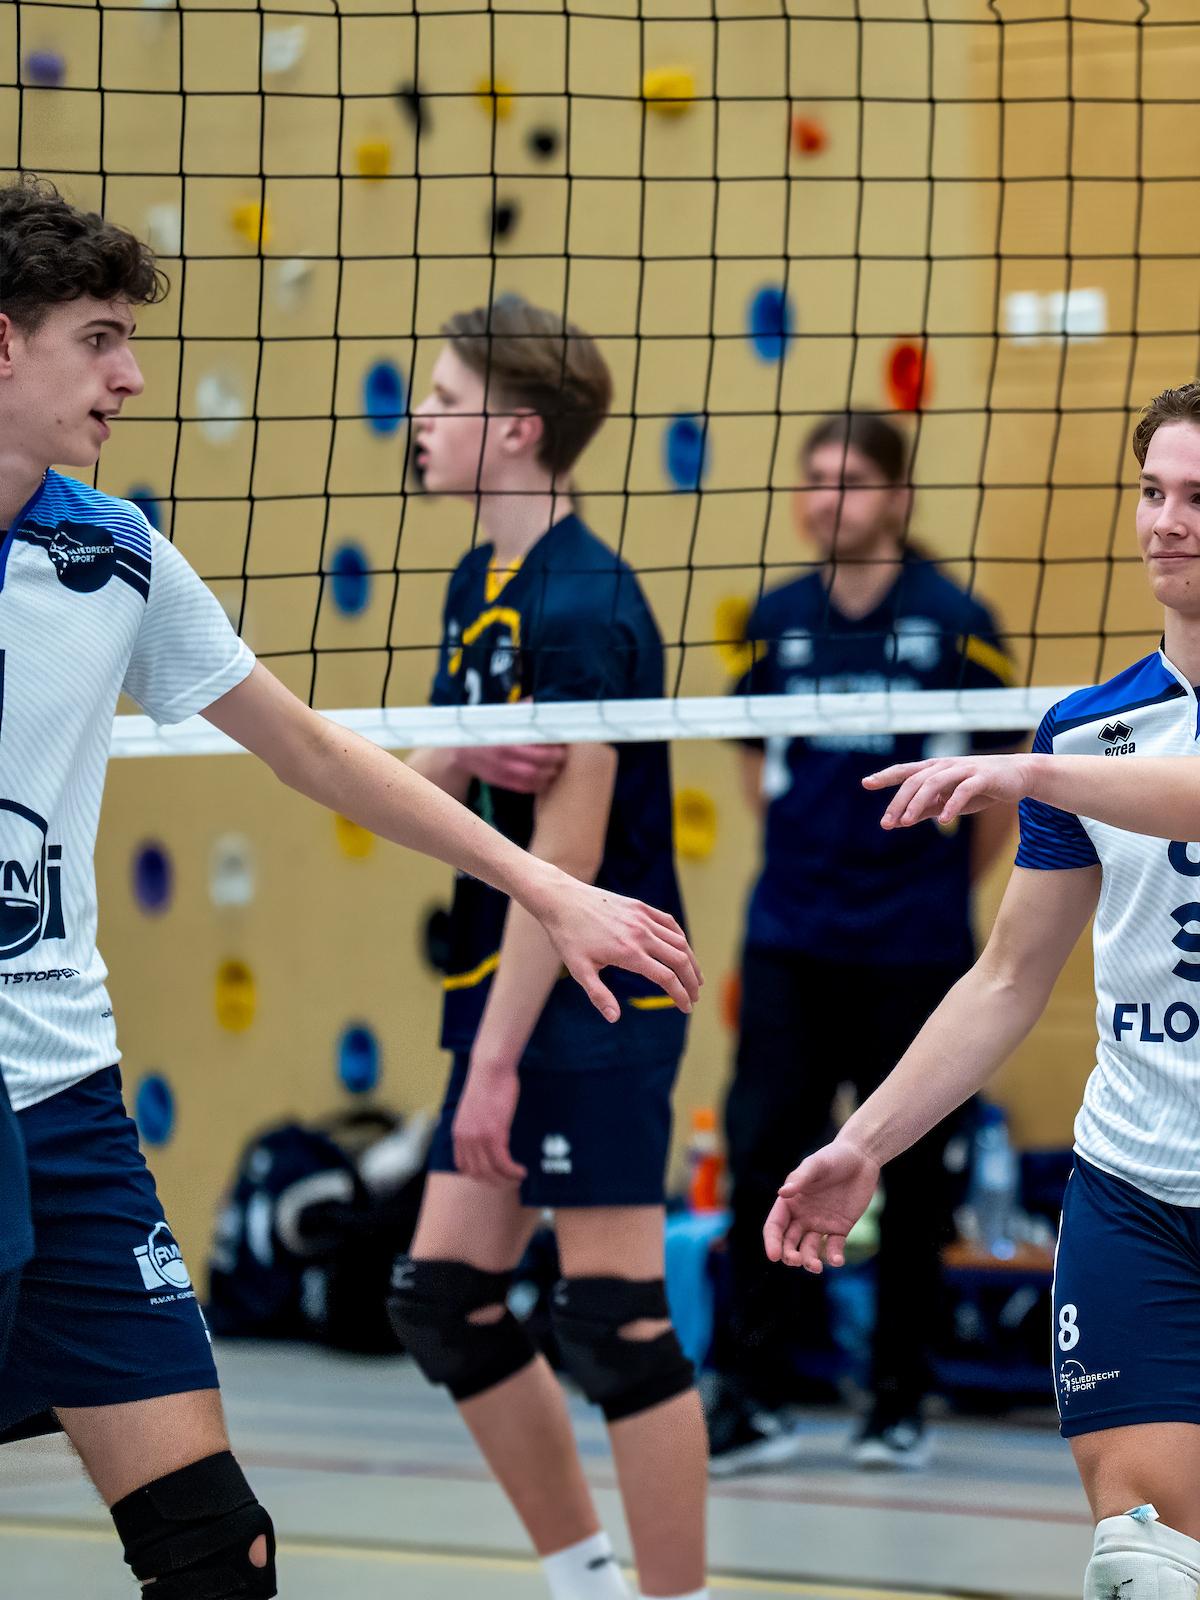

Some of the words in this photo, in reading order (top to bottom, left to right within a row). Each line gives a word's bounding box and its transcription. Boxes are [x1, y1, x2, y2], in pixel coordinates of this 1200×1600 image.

[70, 554, 96, 564] SPORT
[1104, 741, 1136, 757] errea
[1057, 1303, 1080, 1351] 8
[1071, 1370, 1121, 1385] SLIEDRECHT
[1072, 1381, 1097, 1393] SPORT
